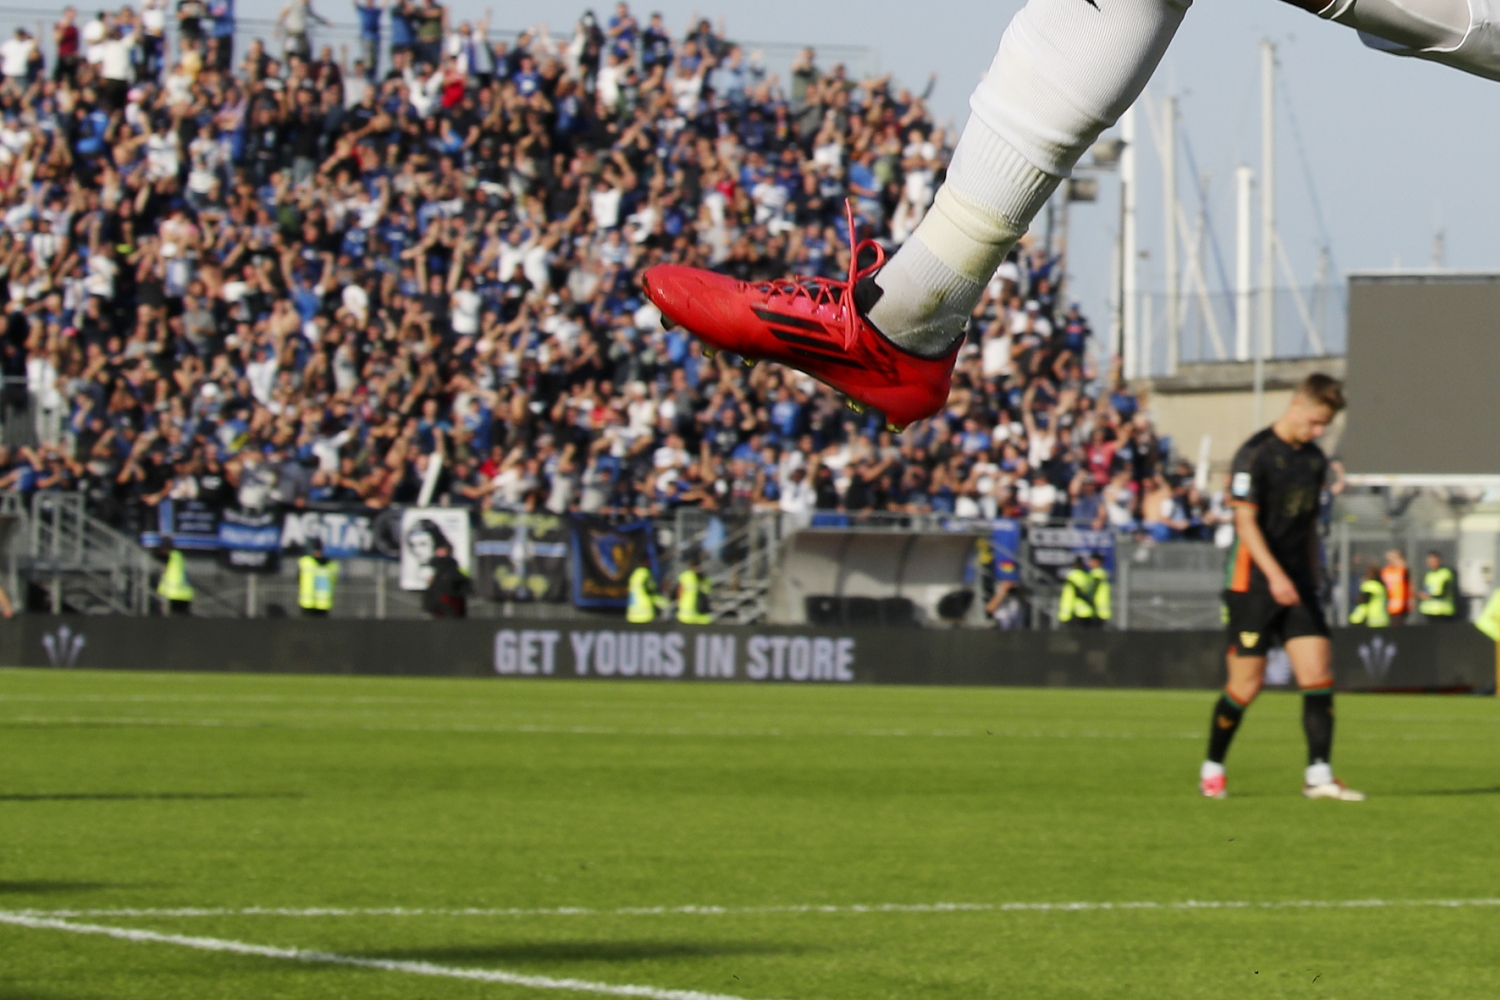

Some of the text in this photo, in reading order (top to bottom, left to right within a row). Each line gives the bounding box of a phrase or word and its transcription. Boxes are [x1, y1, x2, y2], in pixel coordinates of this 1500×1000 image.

[494, 629, 856, 682] GET YOURS IN STORE
